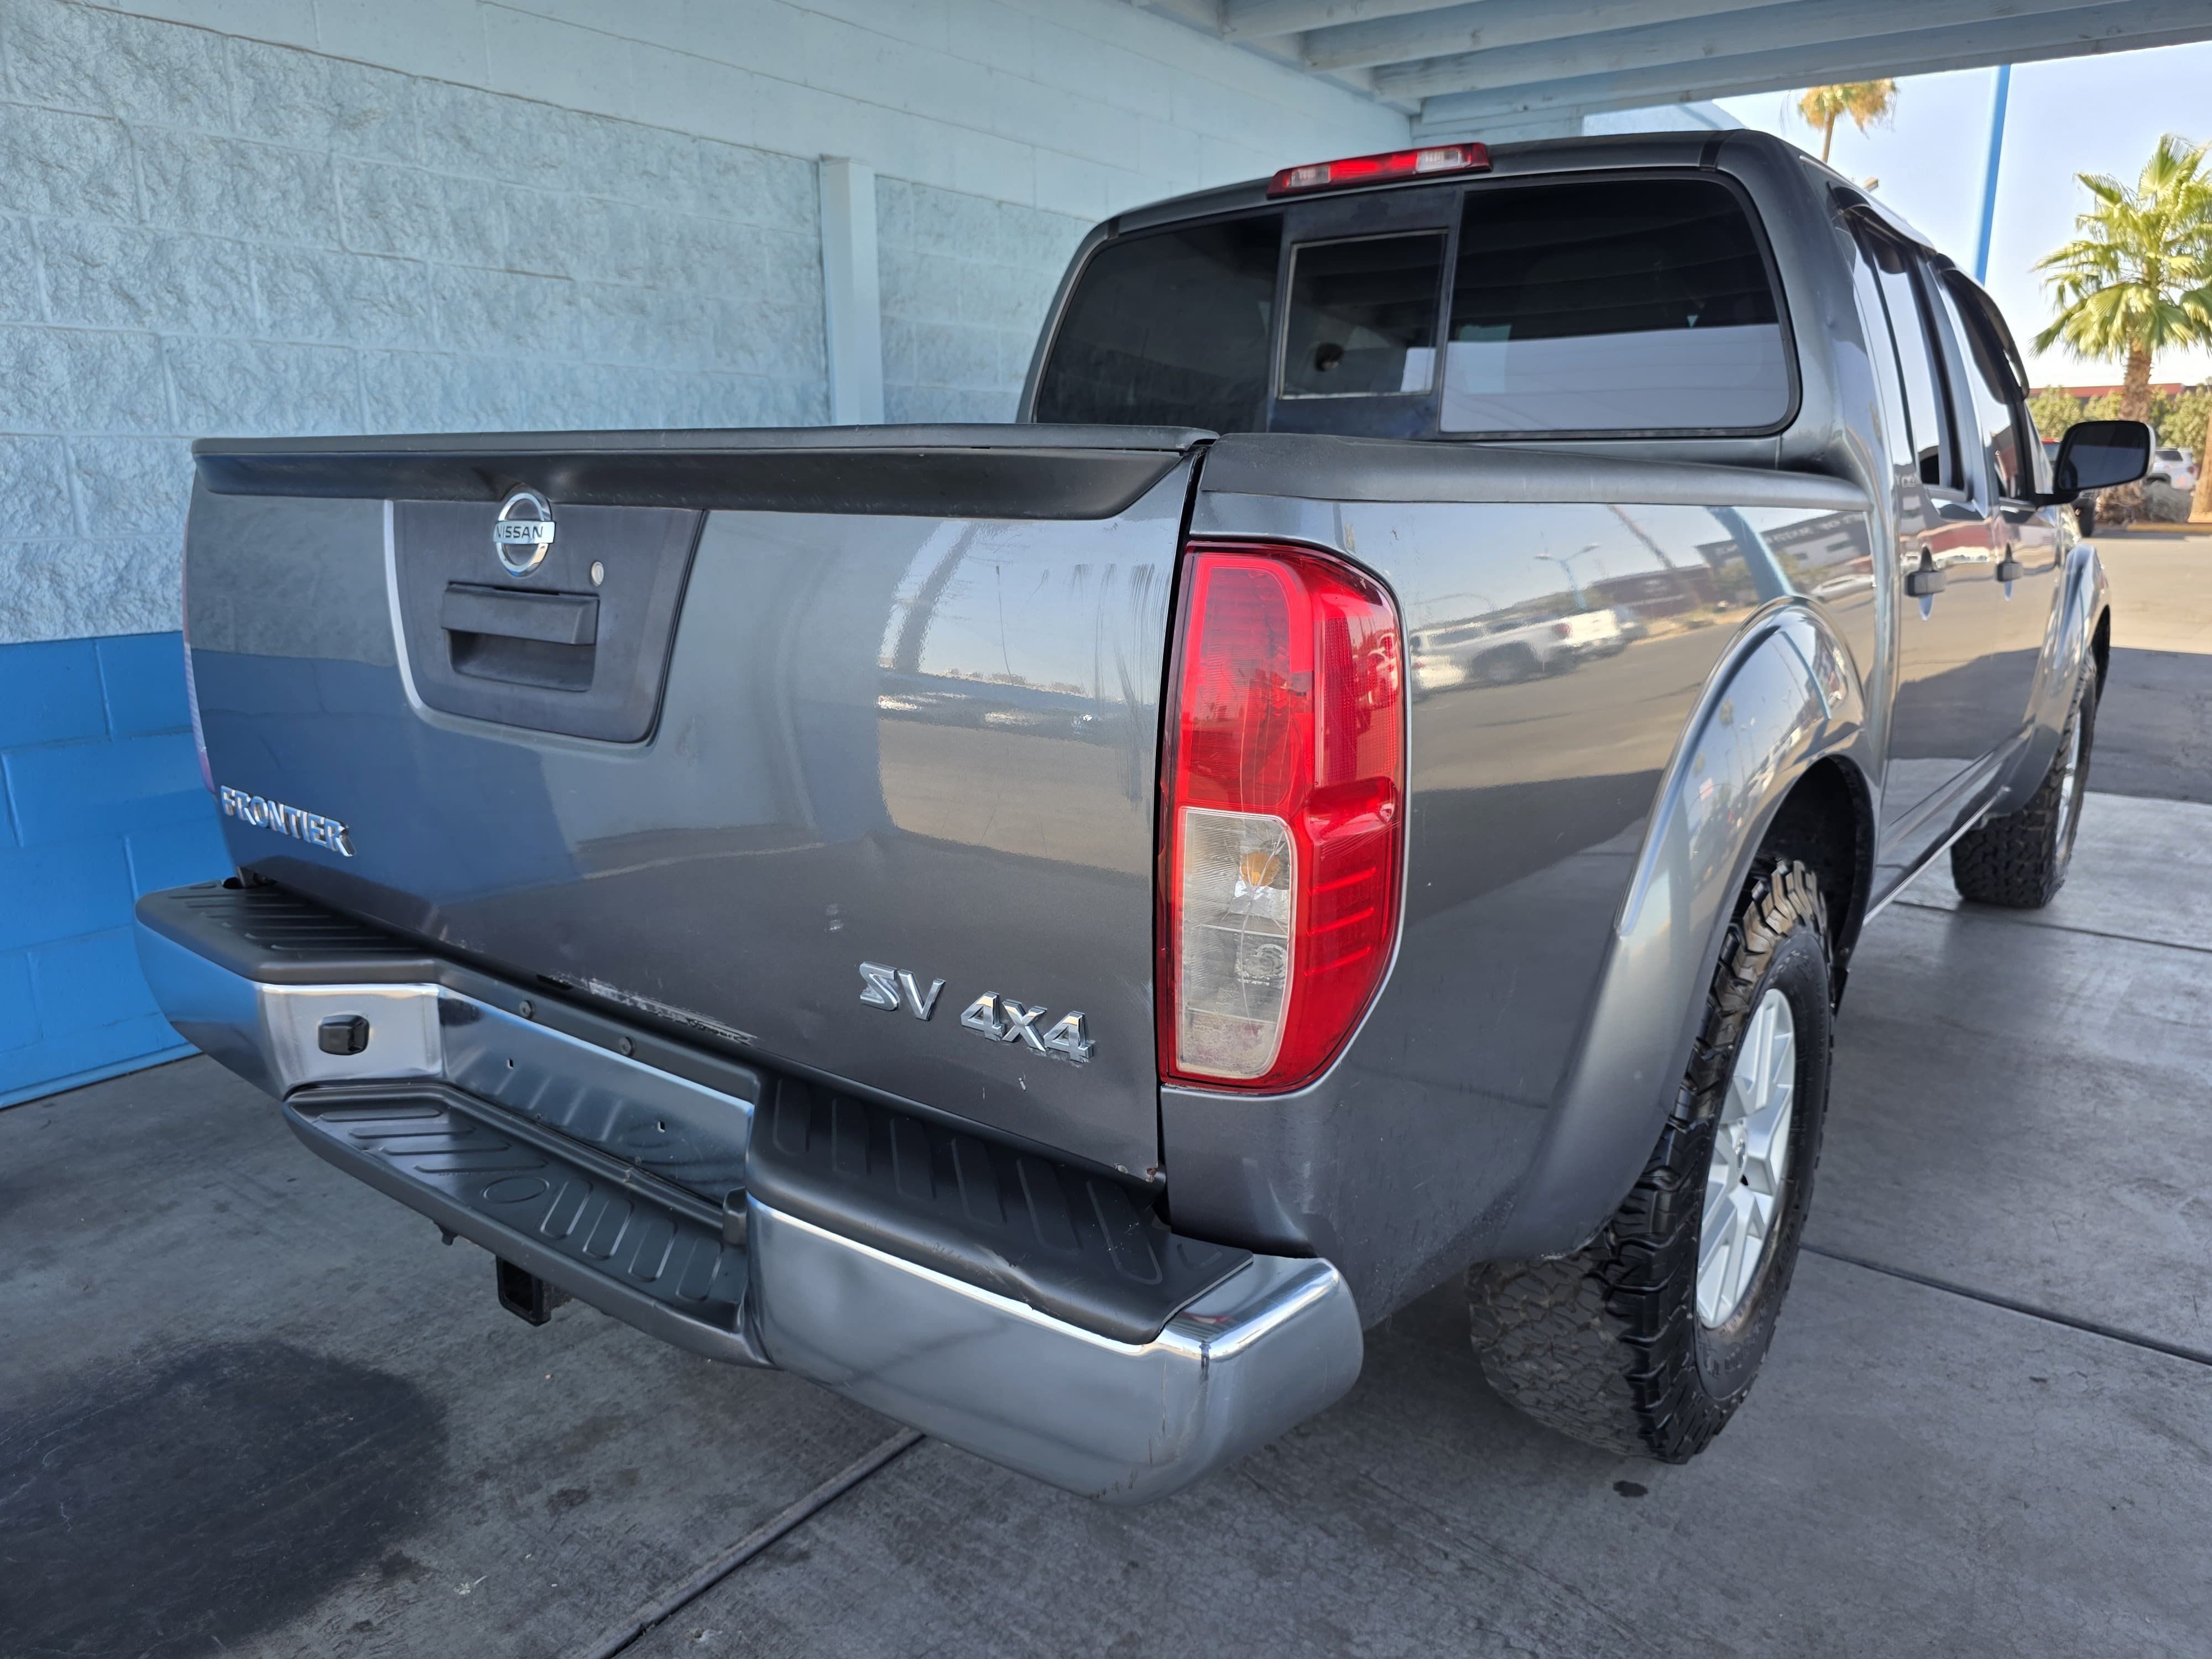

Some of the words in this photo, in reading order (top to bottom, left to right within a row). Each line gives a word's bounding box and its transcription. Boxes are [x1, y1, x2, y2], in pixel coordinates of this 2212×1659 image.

[497, 525, 543, 539] NISSAN
[221, 785, 356, 857] FRONTIER
[859, 961, 945, 1021] SV
